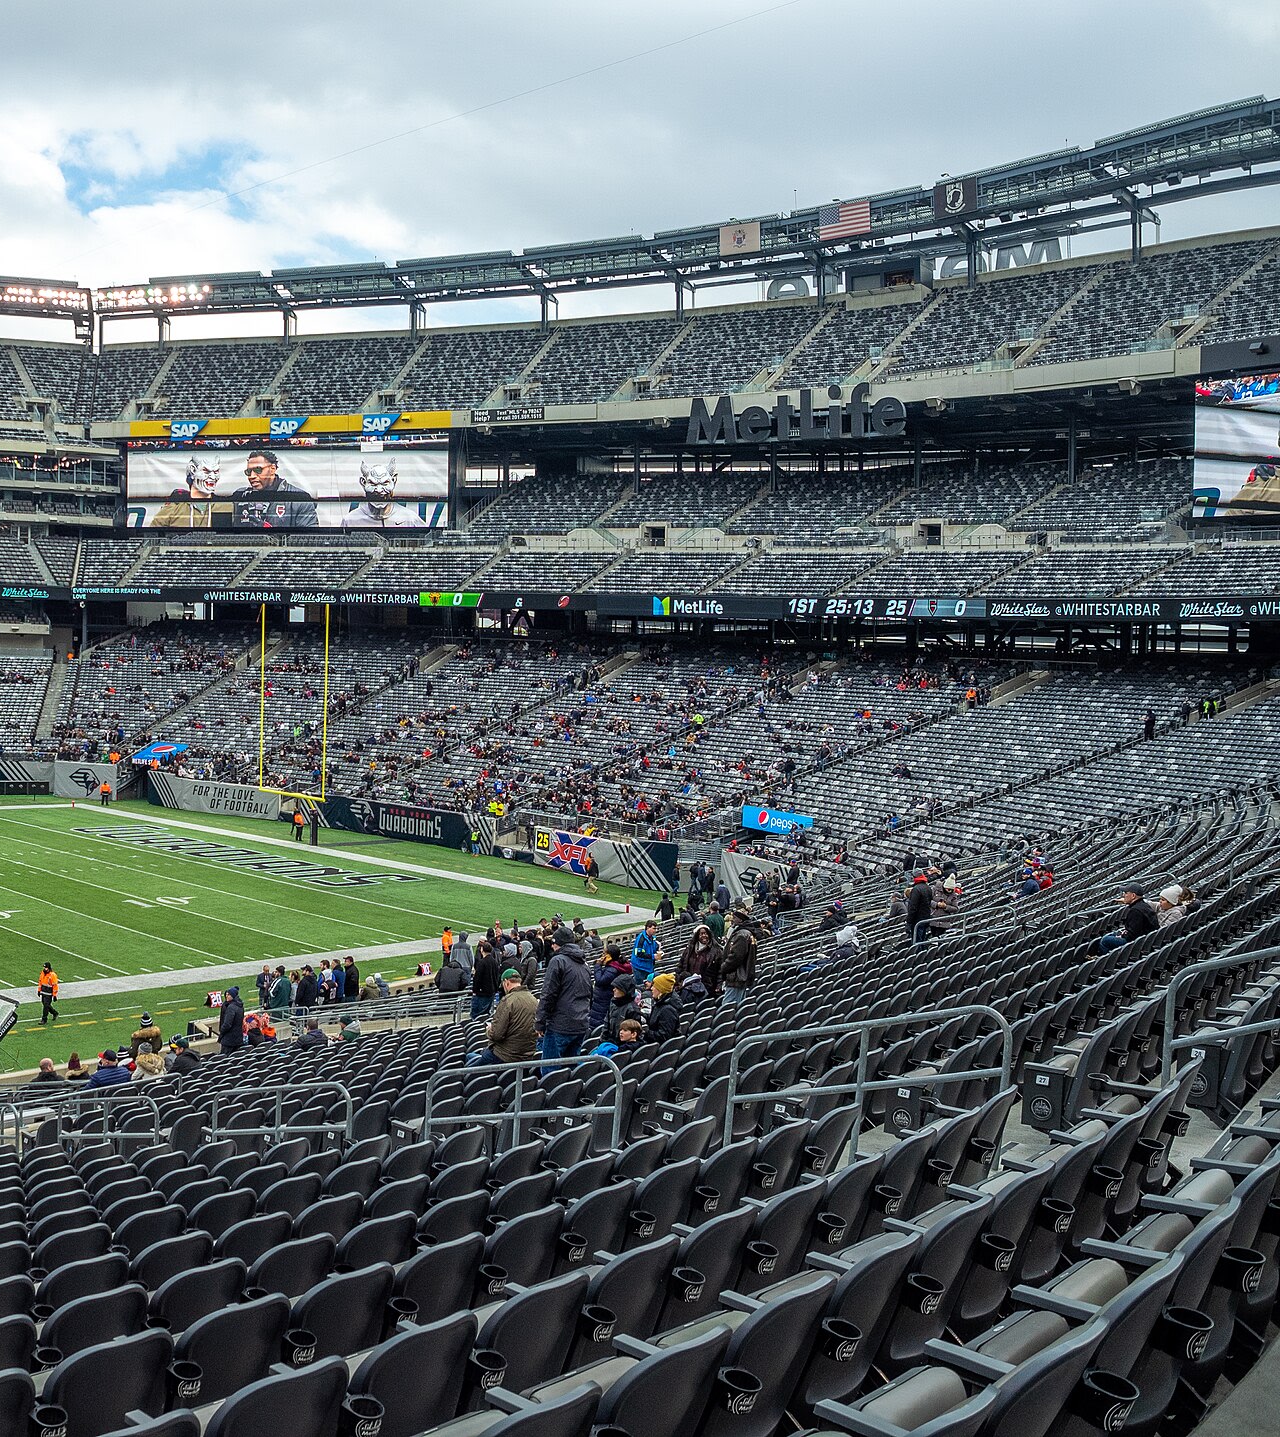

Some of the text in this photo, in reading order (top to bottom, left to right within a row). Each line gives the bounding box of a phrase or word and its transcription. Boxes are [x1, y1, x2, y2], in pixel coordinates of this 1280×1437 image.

[686, 382, 907, 444] MetLife
[171, 423, 198, 437] SAP
[271, 420, 298, 435] SAP
[363, 417, 391, 432] SAP
[204, 591, 281, 602] @WHITESTARBAR
[340, 594, 419, 604] @WHITESTARBAR
[515, 597, 523, 607] &
[673, 600, 723, 615] MetLife
[789, 599, 907, 616] 1ST 25:13 25
[1055, 603, 1160, 616] @WHITESTARBAR
[192, 784, 254, 801] FOR THE LOVE
[210, 799, 269, 815] OF FOOTBALL
[390, 809, 430, 820] NEW YORK
[378, 807, 442, 840] GUARDIANS
[537, 833, 549, 848] 25
[70, 824, 426, 888] GUARDIANS
